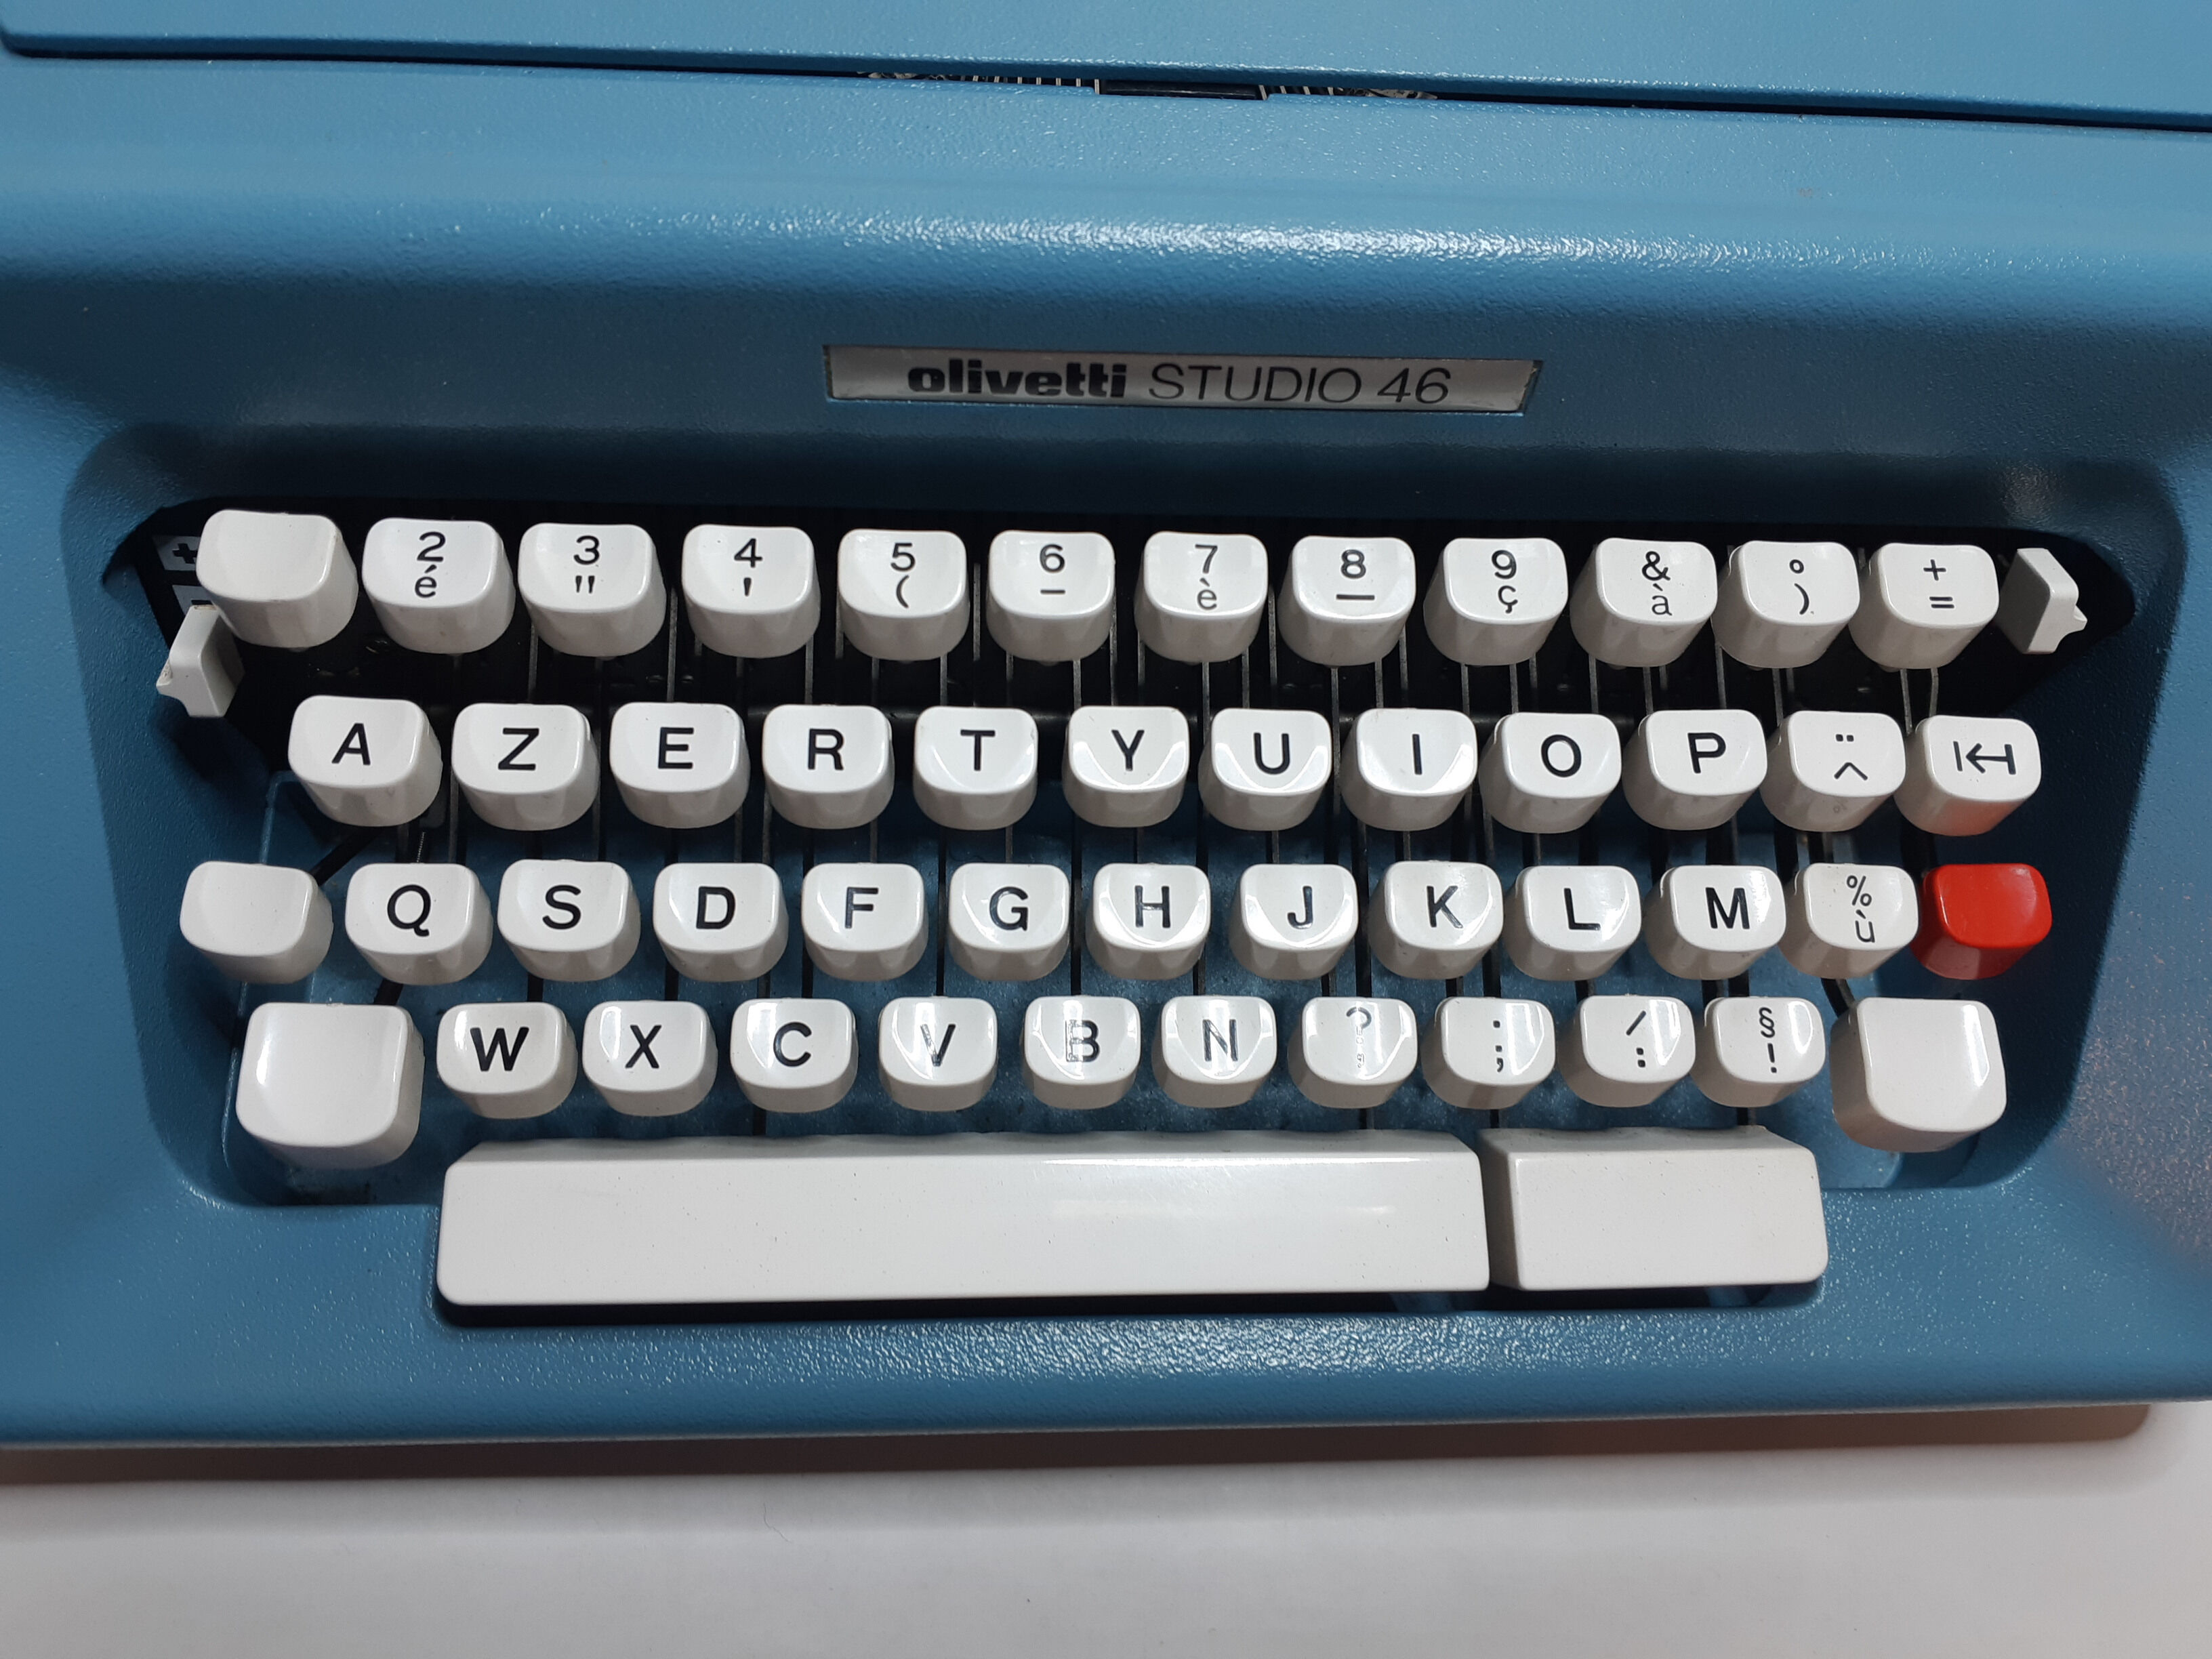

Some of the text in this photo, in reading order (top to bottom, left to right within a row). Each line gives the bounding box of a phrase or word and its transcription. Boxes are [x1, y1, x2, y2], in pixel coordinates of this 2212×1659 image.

[908, 358, 1452, 404] olivetti STUDIO 46
[417, 531, 446, 563] 2
[573, 535, 600, 565] 3
[734, 538, 762, 568] 4
[890, 543, 916, 571] 5
[1040, 544, 1065, 572] 6
[1195, 544, 1217, 573] 7
[1341, 550, 1365, 578] 8
[1492, 550, 1517, 579] 9
[1642, 552, 1669, 581] &
[414, 565, 436, 598] é
[1924, 560, 1946, 581] +
[896, 575, 909, 608] (
[1197, 577, 1217, 610] è
[1498, 586, 1517, 613] ç
[1651, 582, 1672, 615] à
[1795, 583, 1809, 615] )
[1930, 596, 1954, 609] =
[332, 723, 371, 765] A
[497, 728, 539, 771] Z
[658, 726, 694, 769] E
[808, 729, 844, 771] R
[961, 729, 995, 771] T
[1111, 729, 1144, 771] Y
[1254, 733, 1289, 774] U
[1412, 733, 1422, 775] I
[1541, 735, 1582, 777] O
[1688, 732, 1725, 773] P
[387, 884, 431, 937] Q
[543, 885, 581, 929] S
[697, 886, 735, 929] D
[845, 887, 878, 928] F
[990, 887, 1029, 931] G
[1134, 885, 1171, 928] H
[1287, 886, 1313, 929] J
[1427, 885, 1462, 928] K
[1564, 888, 1601, 930] L
[1705, 887, 1750, 929] M
[1847, 875, 1872, 907] %
[1856, 910, 1876, 943] ù
[1065, 1020, 1099, 1063] B
[1202, 1019, 1239, 1061] N
[1346, 1006, 1372, 1044] ?
[1626, 1010, 1646, 1036] /
[1759, 1007, 1776, 1038] §
[470, 1027, 529, 1071] W
[625, 1025, 662, 1068] X
[773, 1022, 811, 1067] C
[921, 1024, 956, 1066] V
[1768, 1043, 1777, 1073] !
